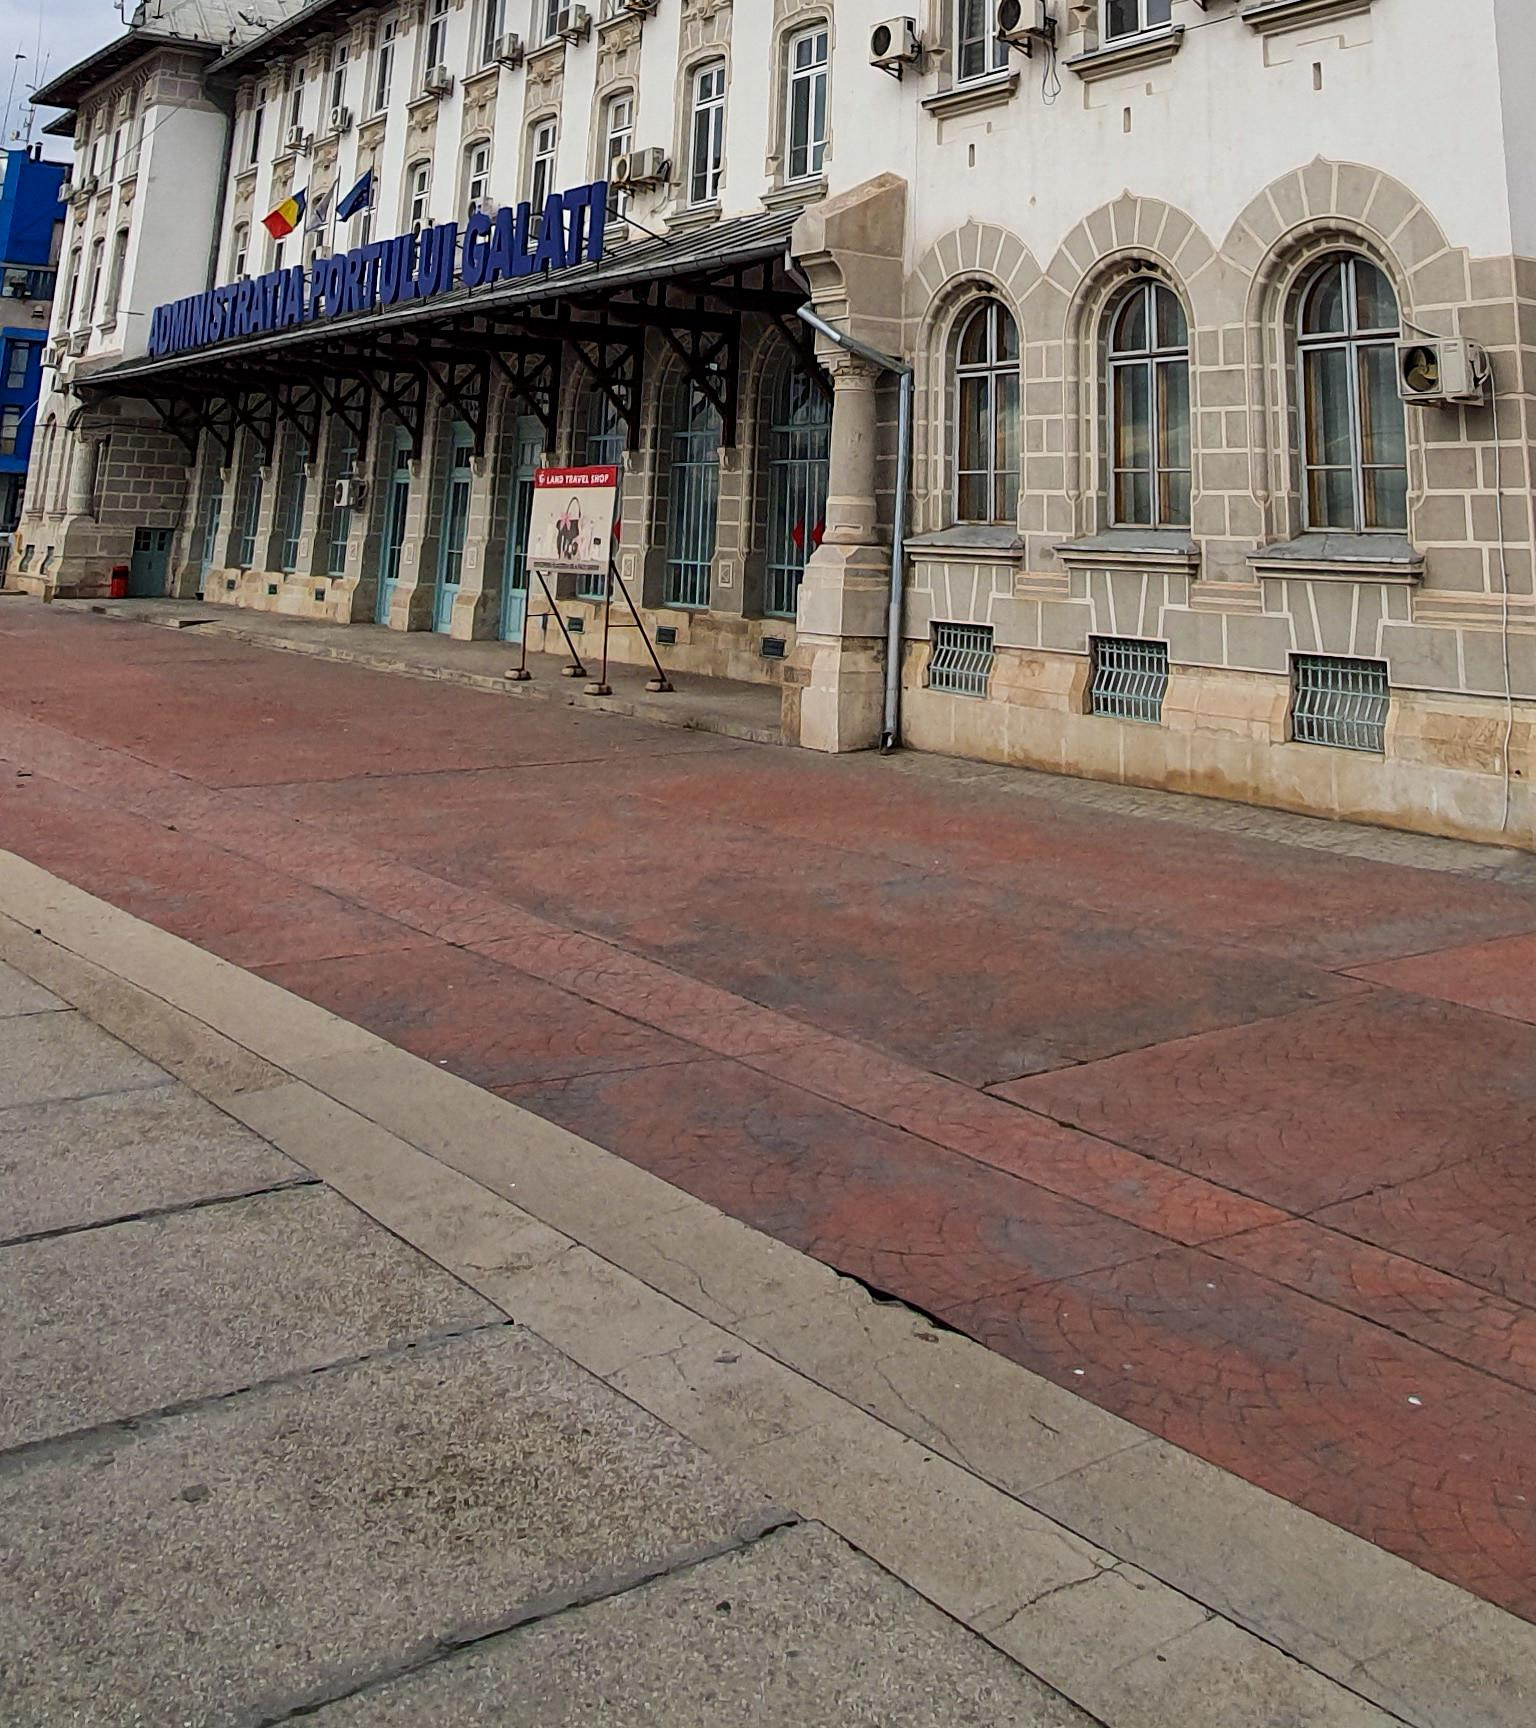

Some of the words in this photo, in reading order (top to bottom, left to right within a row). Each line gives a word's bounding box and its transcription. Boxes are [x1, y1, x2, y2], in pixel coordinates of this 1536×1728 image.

[147, 264, 305, 357] ADMINISTRATIA
[308, 222, 458, 321] PORTULUI
[463, 180, 608, 288] GALATI
[565, 474, 590, 484] TRAVEL
[591, 473, 610, 484] SHOP
